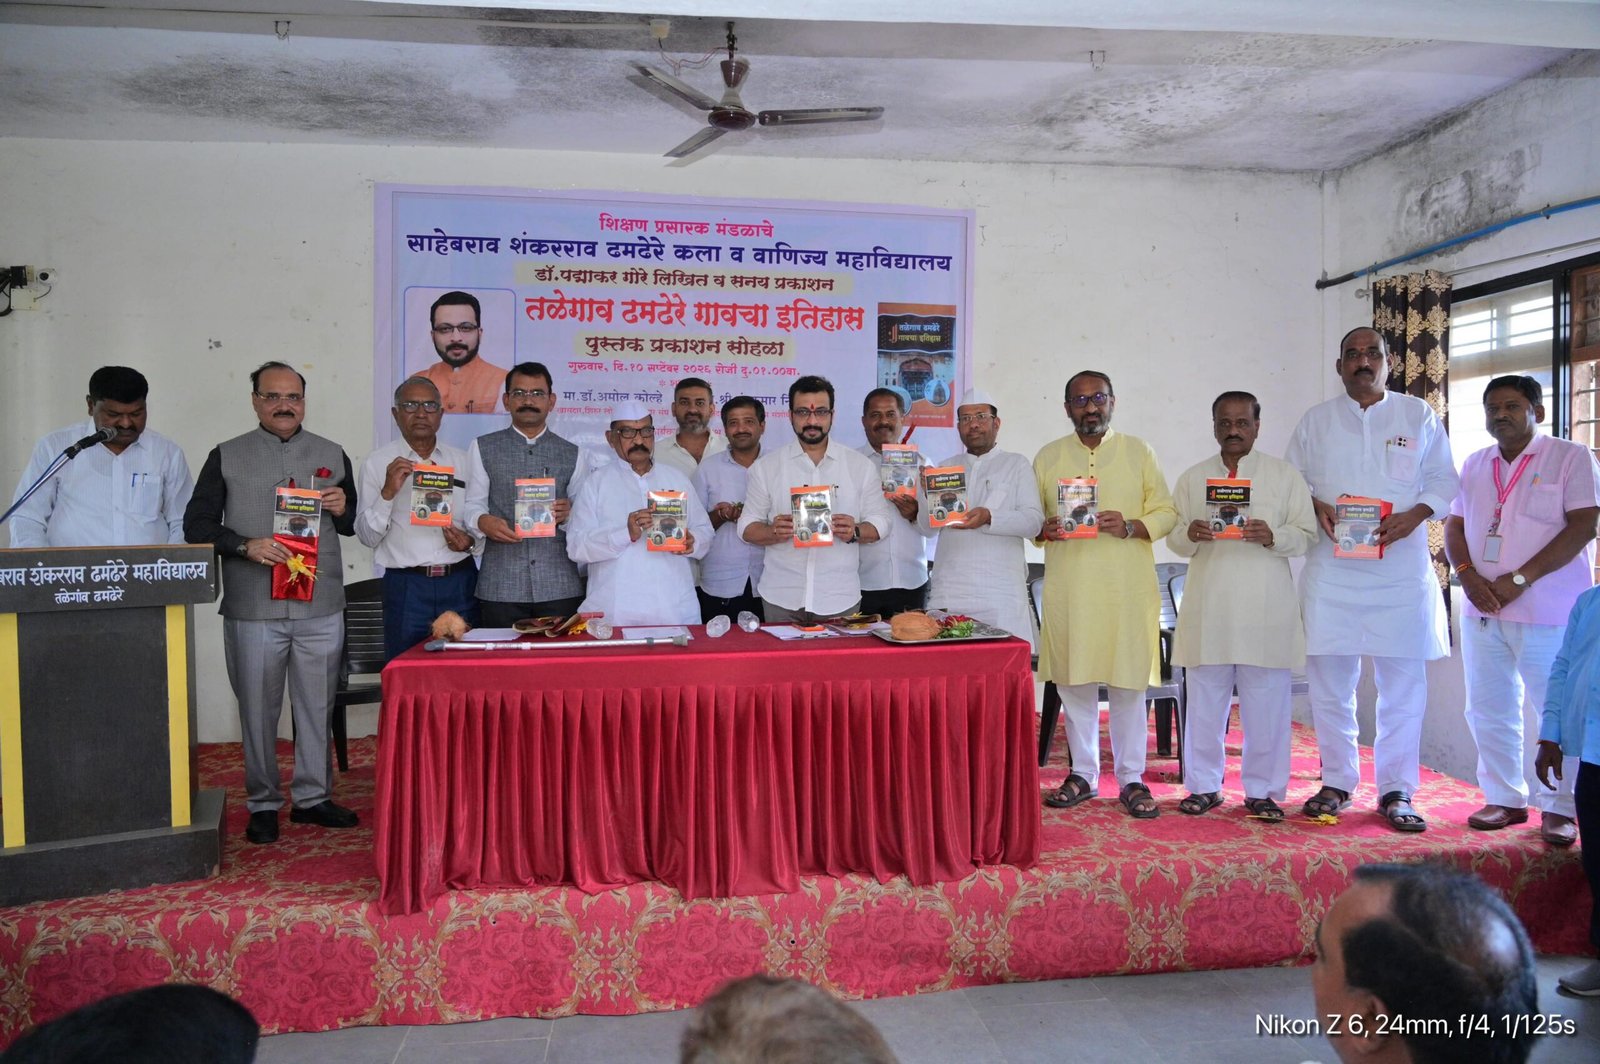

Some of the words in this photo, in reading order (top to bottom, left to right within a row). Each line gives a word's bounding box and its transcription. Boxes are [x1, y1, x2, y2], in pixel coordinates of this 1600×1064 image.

[599, 212, 648, 233] शिक्षण
[655, 219, 709, 236] प्रसारक
[716, 218, 774, 238] मंडळाचे
[406, 228, 501, 256] साहेबराव
[510, 231, 598, 259] शंकरराव
[606, 235, 665, 262] ढमढेरे
[673, 244, 722, 263] कला
[730, 246, 744, 263] व
[753, 241, 828, 267] वाणिज्य
[836, 245, 953, 272] महाविद्यालय
[622, 268, 648, 286] गोरे
[653, 269, 708, 287] लिखित
[713, 275, 725, 288] व
[774, 277, 834, 291] प्रकाशन
[525, 289, 615, 324] तळेगाव
[621, 292, 687, 327] ढमढेरे
[694, 301, 769, 329] गावचा
[775, 298, 865, 333] इतिहास
[585, 336, 645, 357] पुस्तक
[650, 338, 721, 356] प्रकाशन
[727, 336, 785, 357] सोहळा
[715, 362, 737, 375] रोजी
[30, 561, 86, 586] शंकरराव
[91, 559, 130, 583] ढमढेरे
[132, 558, 209, 584] महाविद्यालय
[54, 588, 91, 605] तळेगांव
[93, 585, 125, 602] ढमढेरे
